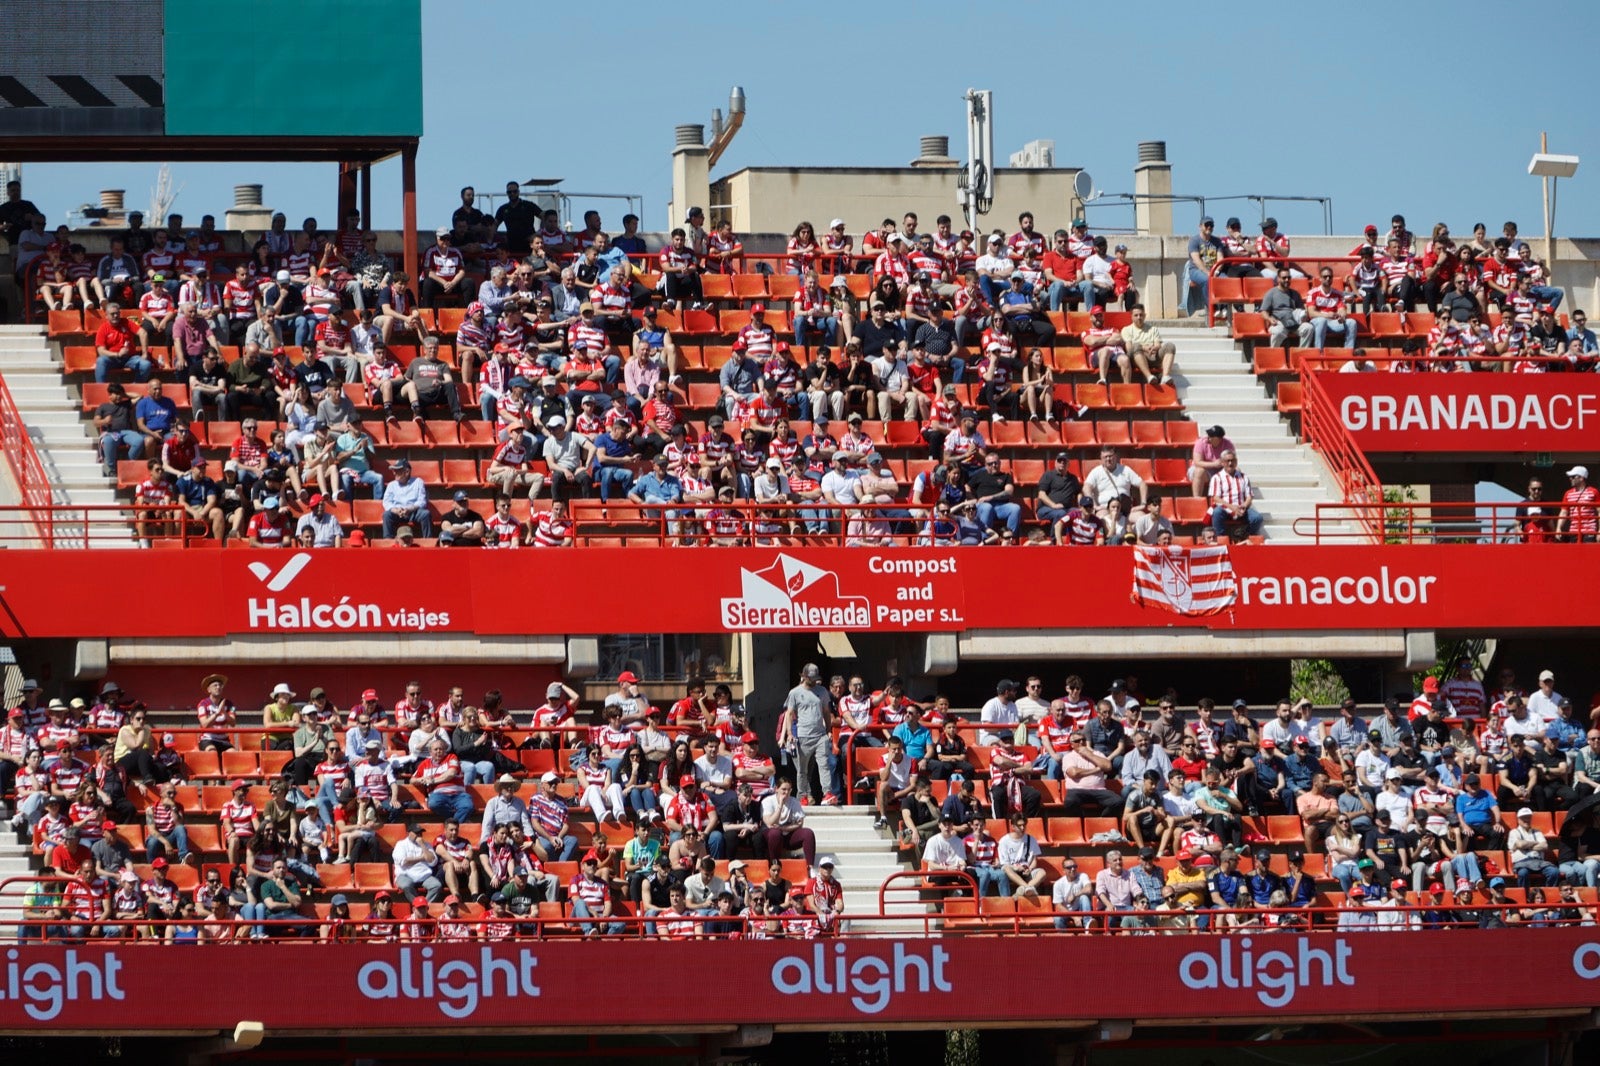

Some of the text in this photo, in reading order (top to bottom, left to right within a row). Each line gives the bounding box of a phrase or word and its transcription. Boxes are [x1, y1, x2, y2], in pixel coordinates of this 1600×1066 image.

[868, 556, 957, 578] Compost
[1236, 565, 1438, 605] ranacolor
[896, 581, 933, 601] and
[248, 595, 451, 632] Halcón viajes
[876, 605, 964, 627] Paper S.L.
[0, 949, 125, 1021] ight
[357, 946, 541, 1019] alight
[771, 942, 952, 1014] alight
[1179, 937, 1355, 1008] alight
